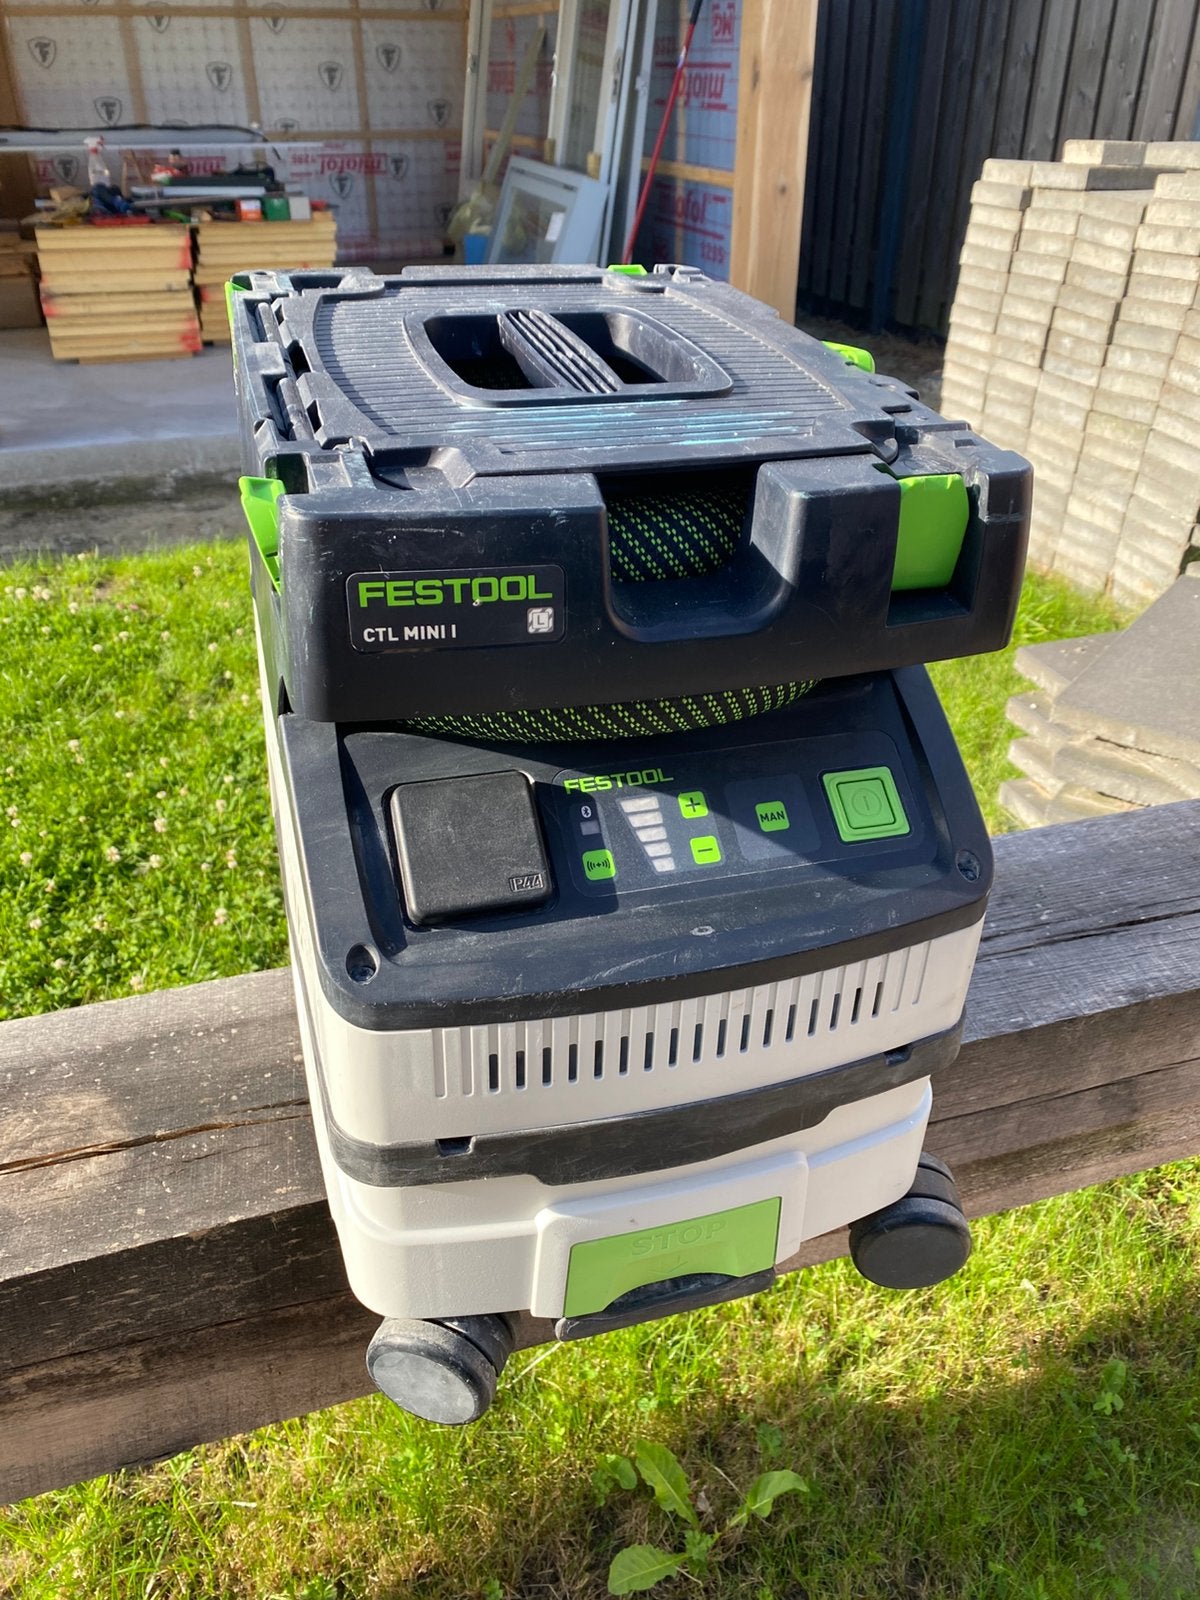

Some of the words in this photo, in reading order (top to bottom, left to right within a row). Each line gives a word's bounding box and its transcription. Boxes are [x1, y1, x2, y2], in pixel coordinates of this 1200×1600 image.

[358, 575, 552, 607] FESTOOL
[363, 627, 399, 642] CTL
[404, 625, 446, 640] MINI
[451, 624, 457, 638] I
[564, 768, 674, 794] FESTOOL
[759, 810, 785, 823] MAN
[631, 1218, 727, 1256] STOP
